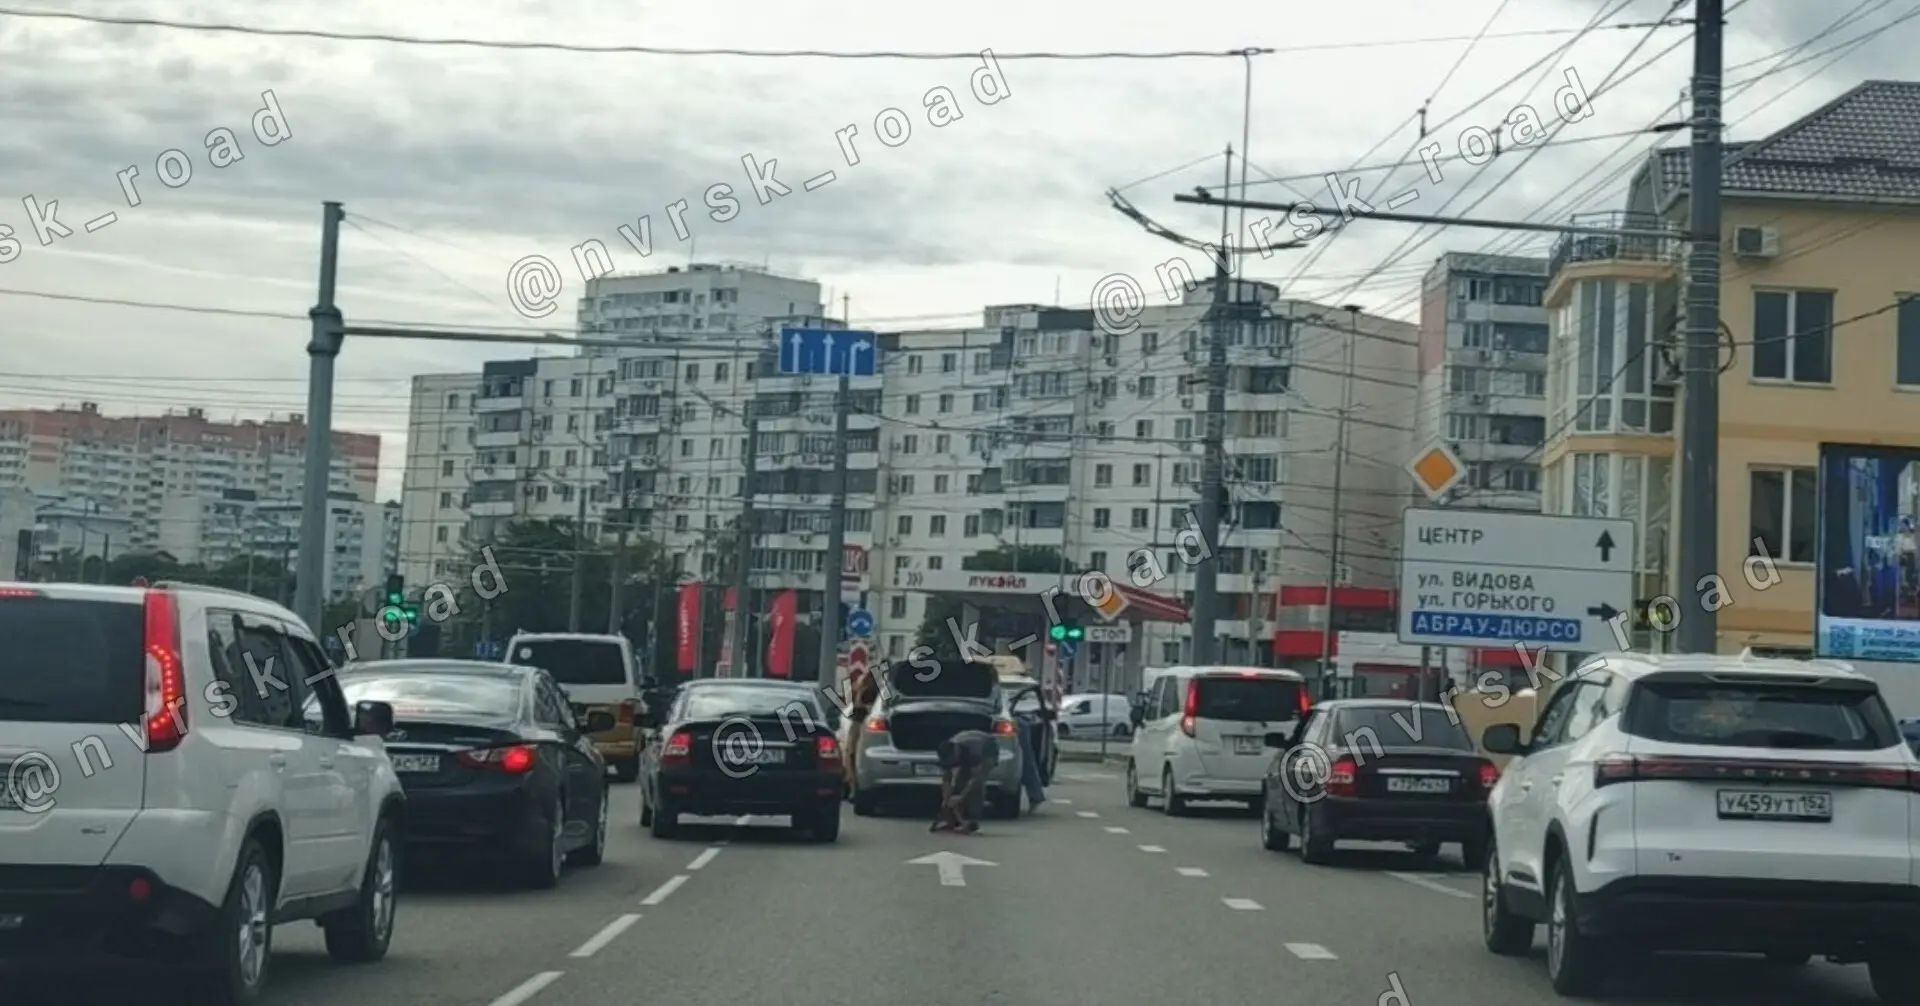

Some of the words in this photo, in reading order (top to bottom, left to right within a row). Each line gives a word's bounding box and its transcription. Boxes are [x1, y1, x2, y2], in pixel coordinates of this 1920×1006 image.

[1418, 527, 1484, 546] ЦЕНТР
[1417, 573, 1444, 589] ул.
[1452, 572, 1535, 591] ВИДОВА
[1417, 594, 1444, 610] ул.
[1452, 592, 1555, 612] ГОРЬКОГО
[1091, 628, 1126, 640] СТОП
[1414, 614, 1579, 639] АБРАУ-ДЮРСО
